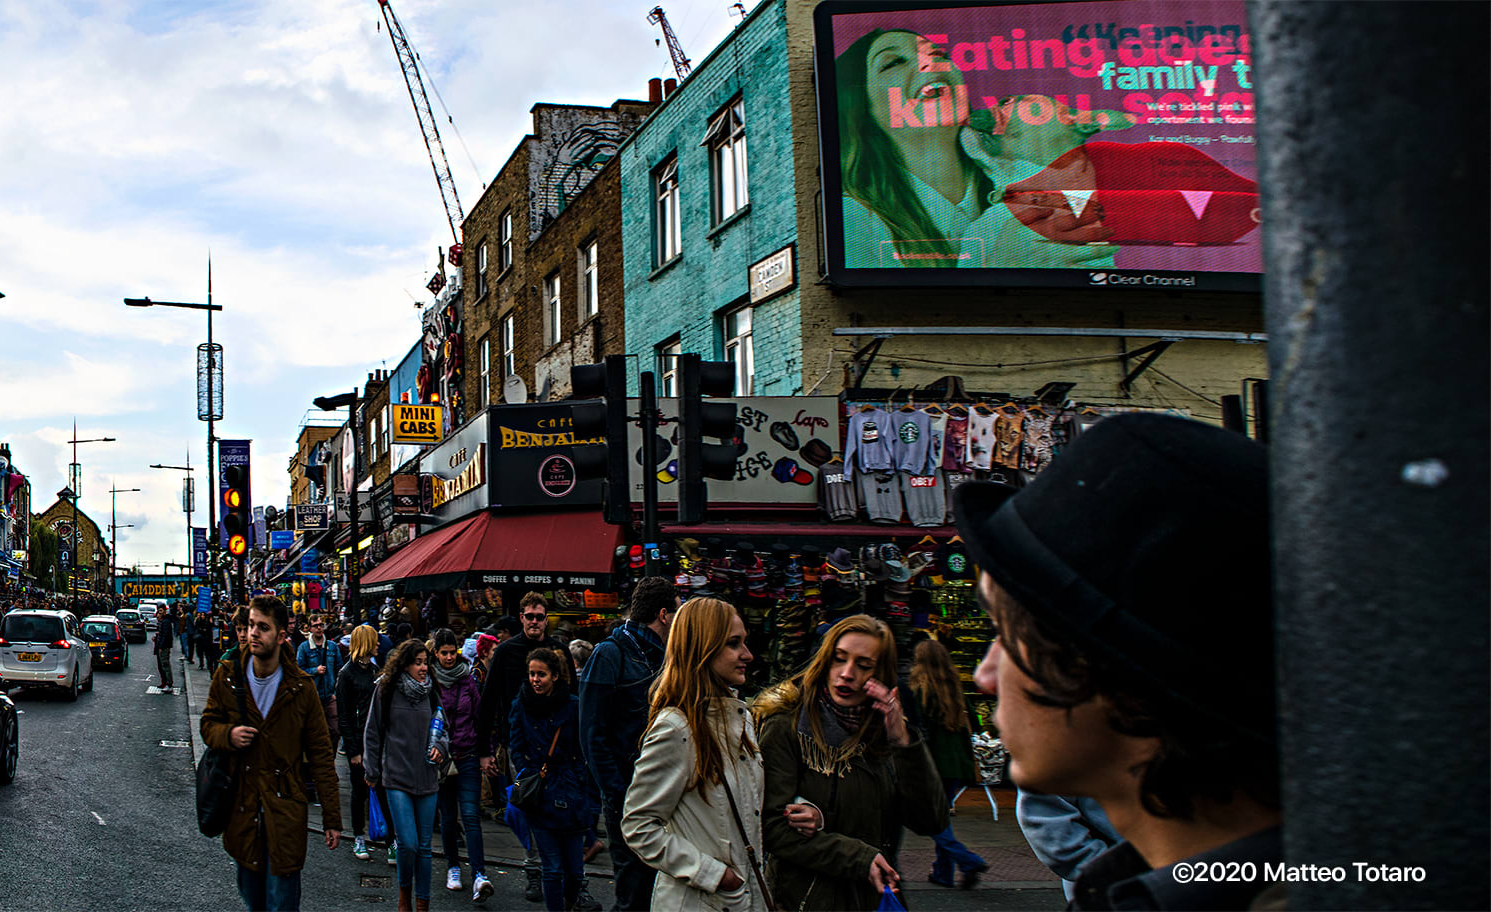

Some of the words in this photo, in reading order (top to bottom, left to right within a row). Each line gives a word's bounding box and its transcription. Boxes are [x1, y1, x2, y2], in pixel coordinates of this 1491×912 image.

[916, 28, 1107, 78] Eating
[1098, 61, 1219, 96] family
[890, 86, 969, 128] kill
[1180, 102, 1214, 111] tickled
[1217, 102, 1241, 113] pink
[1108, 274, 1141, 285] Clear
[1143, 274, 1196, 286] Channel
[400, 407, 435, 420] MINI
[399, 421, 436, 434] CABS
[790, 409, 829, 436] Caps
[431, 446, 481, 509] BENJAMIN
[911, 477, 934, 486] OBEY
[304, 515, 322, 523] SHOP
[524, 576, 551, 584] CREPES
[570, 577, 595, 585] PANINI
